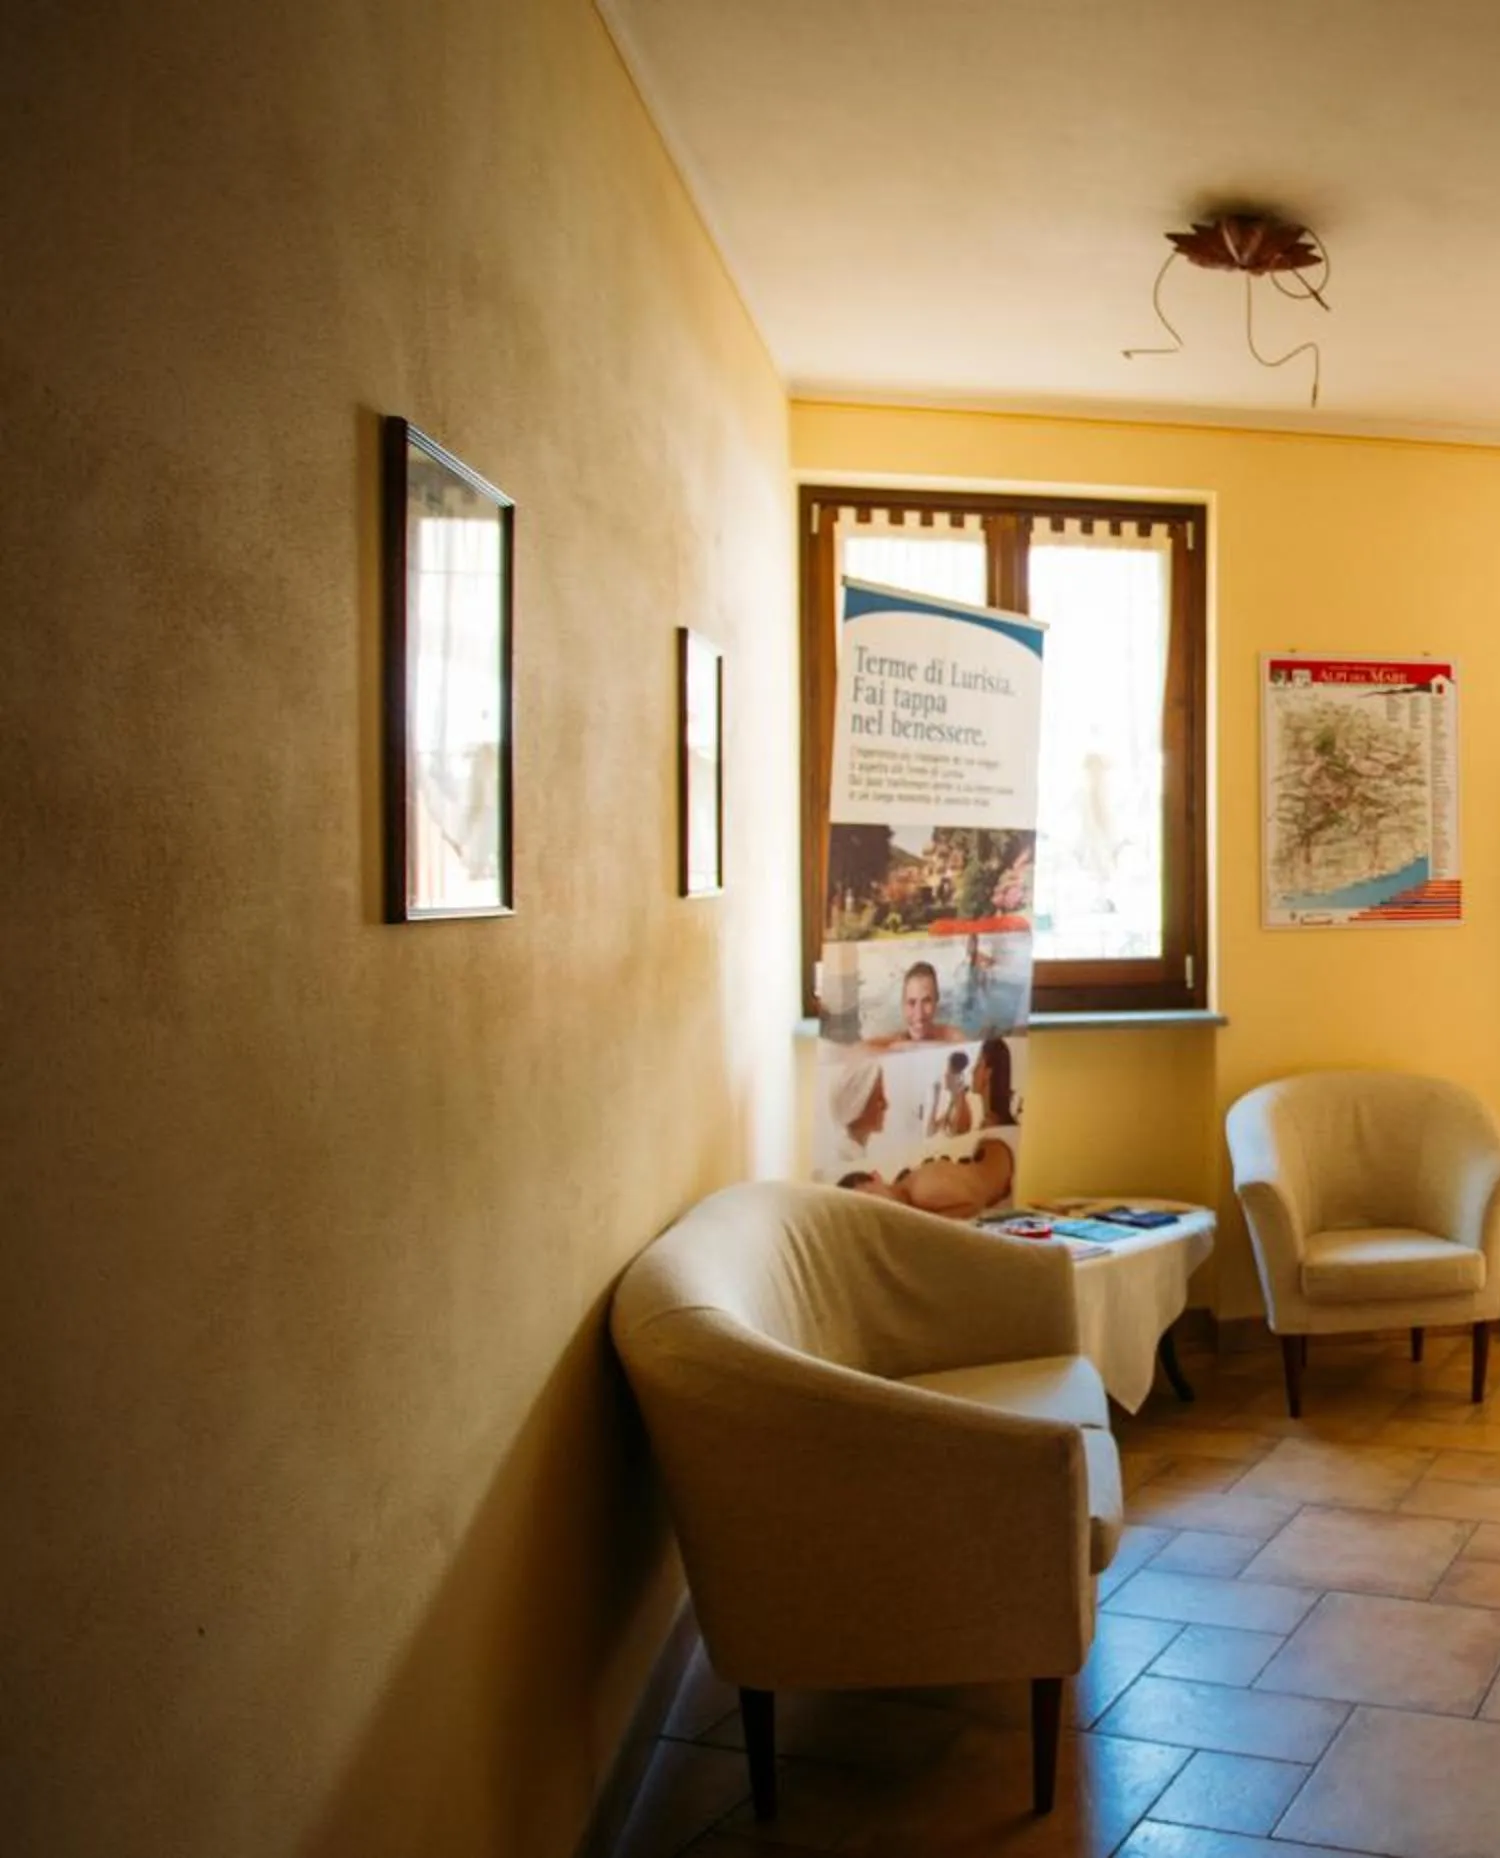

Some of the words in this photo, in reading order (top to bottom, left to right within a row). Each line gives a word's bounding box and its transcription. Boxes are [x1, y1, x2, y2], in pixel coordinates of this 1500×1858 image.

[853, 644, 918, 682] Terme
[924, 657, 943, 685] di
[1370, 670, 1407, 684] MARE
[851, 676, 886, 706] Fai
[893, 686, 947, 719] tappa
[850, 708, 884, 735] nel
[890, 715, 988, 747] benessere.
